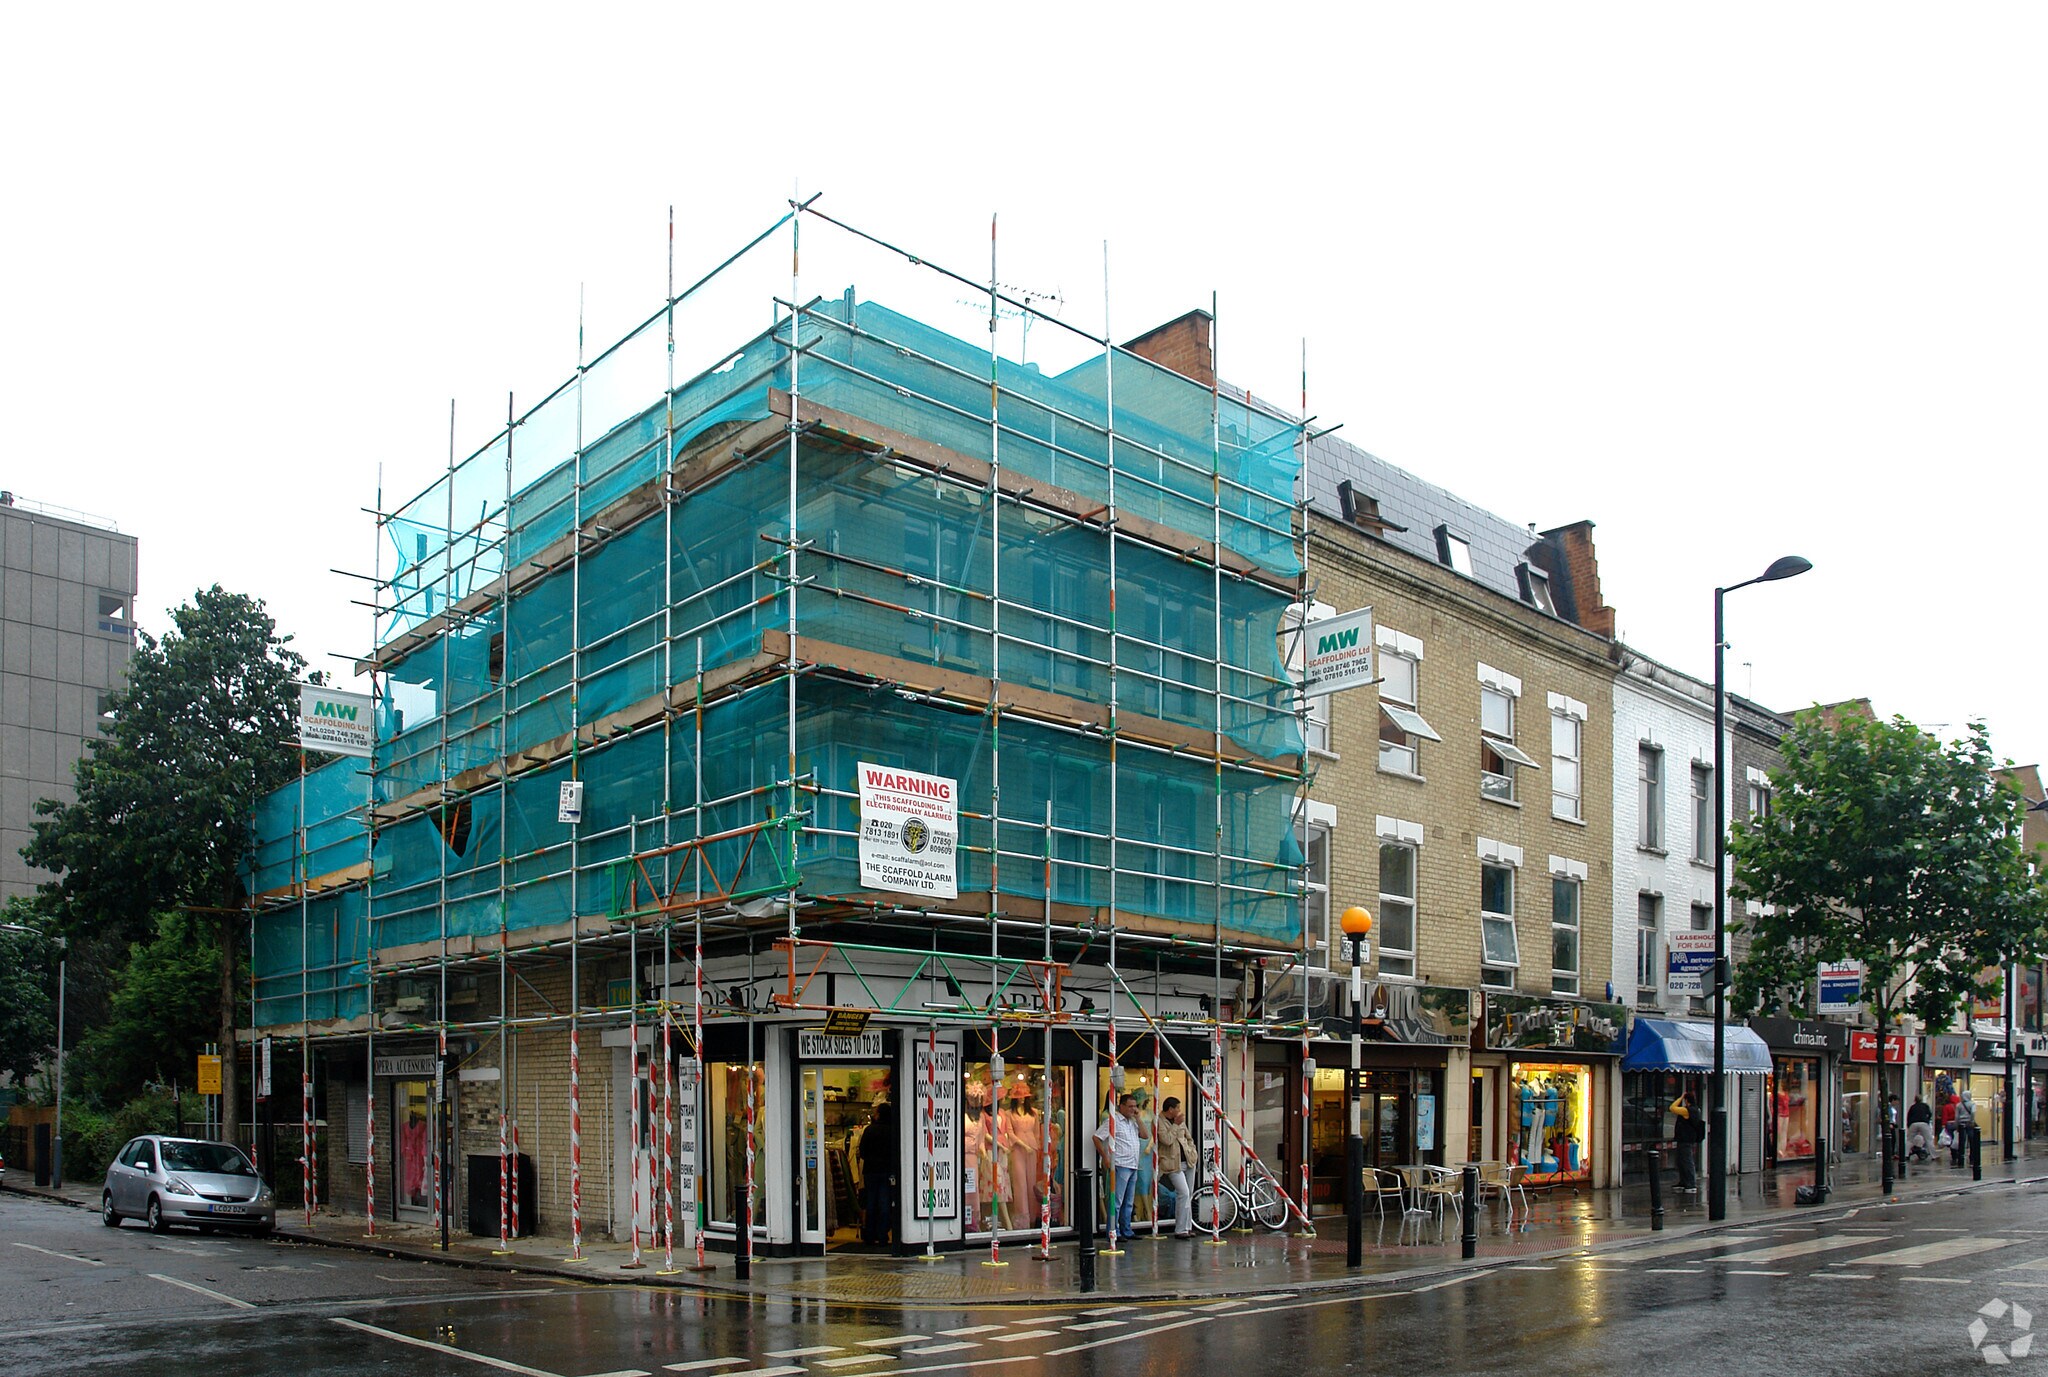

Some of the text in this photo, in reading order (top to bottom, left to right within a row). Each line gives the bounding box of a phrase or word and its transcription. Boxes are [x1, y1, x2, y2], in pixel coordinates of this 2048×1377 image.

[1317, 627, 1359, 655] MW
[1308, 645, 1370, 668] SCAFFOLDING Ltd
[1323, 665, 1334, 674] 020
[314, 700, 359, 721] MW
[303, 716, 370, 732] SCAFFOLDING Ltd
[866, 769, 951, 799] WARNING
[866, 800, 953, 821] ELECTRONICALLY ALARMED
[874, 793, 944, 812] THIS SCAFFOLDING IS
[865, 826, 899, 840] 7813 1891
[879, 820, 893, 829] 020
[871, 852, 891, 862] e-mail:
[865, 862, 952, 883] THE SCAFFOLD ALARM
[881, 874, 936, 890] COMPANY LTD.
[1694, 941, 1714, 949] SALE
[836, 1011, 865, 1020] DANGER
[800, 1034, 880, 1055] WE STOCK SIZES 10 TO 28
[374, 1057, 436, 1074] OPERA ACCESSORIES
[939, 1051, 955, 1072] SUITS
[942, 1080, 955, 1099] SUIT
[680, 1104, 695, 1117] STRAW
[944, 1108, 951, 1127] OF
[934, 1129, 949, 1148] BRIDE
[936, 1161, 951, 1182] SUITS
